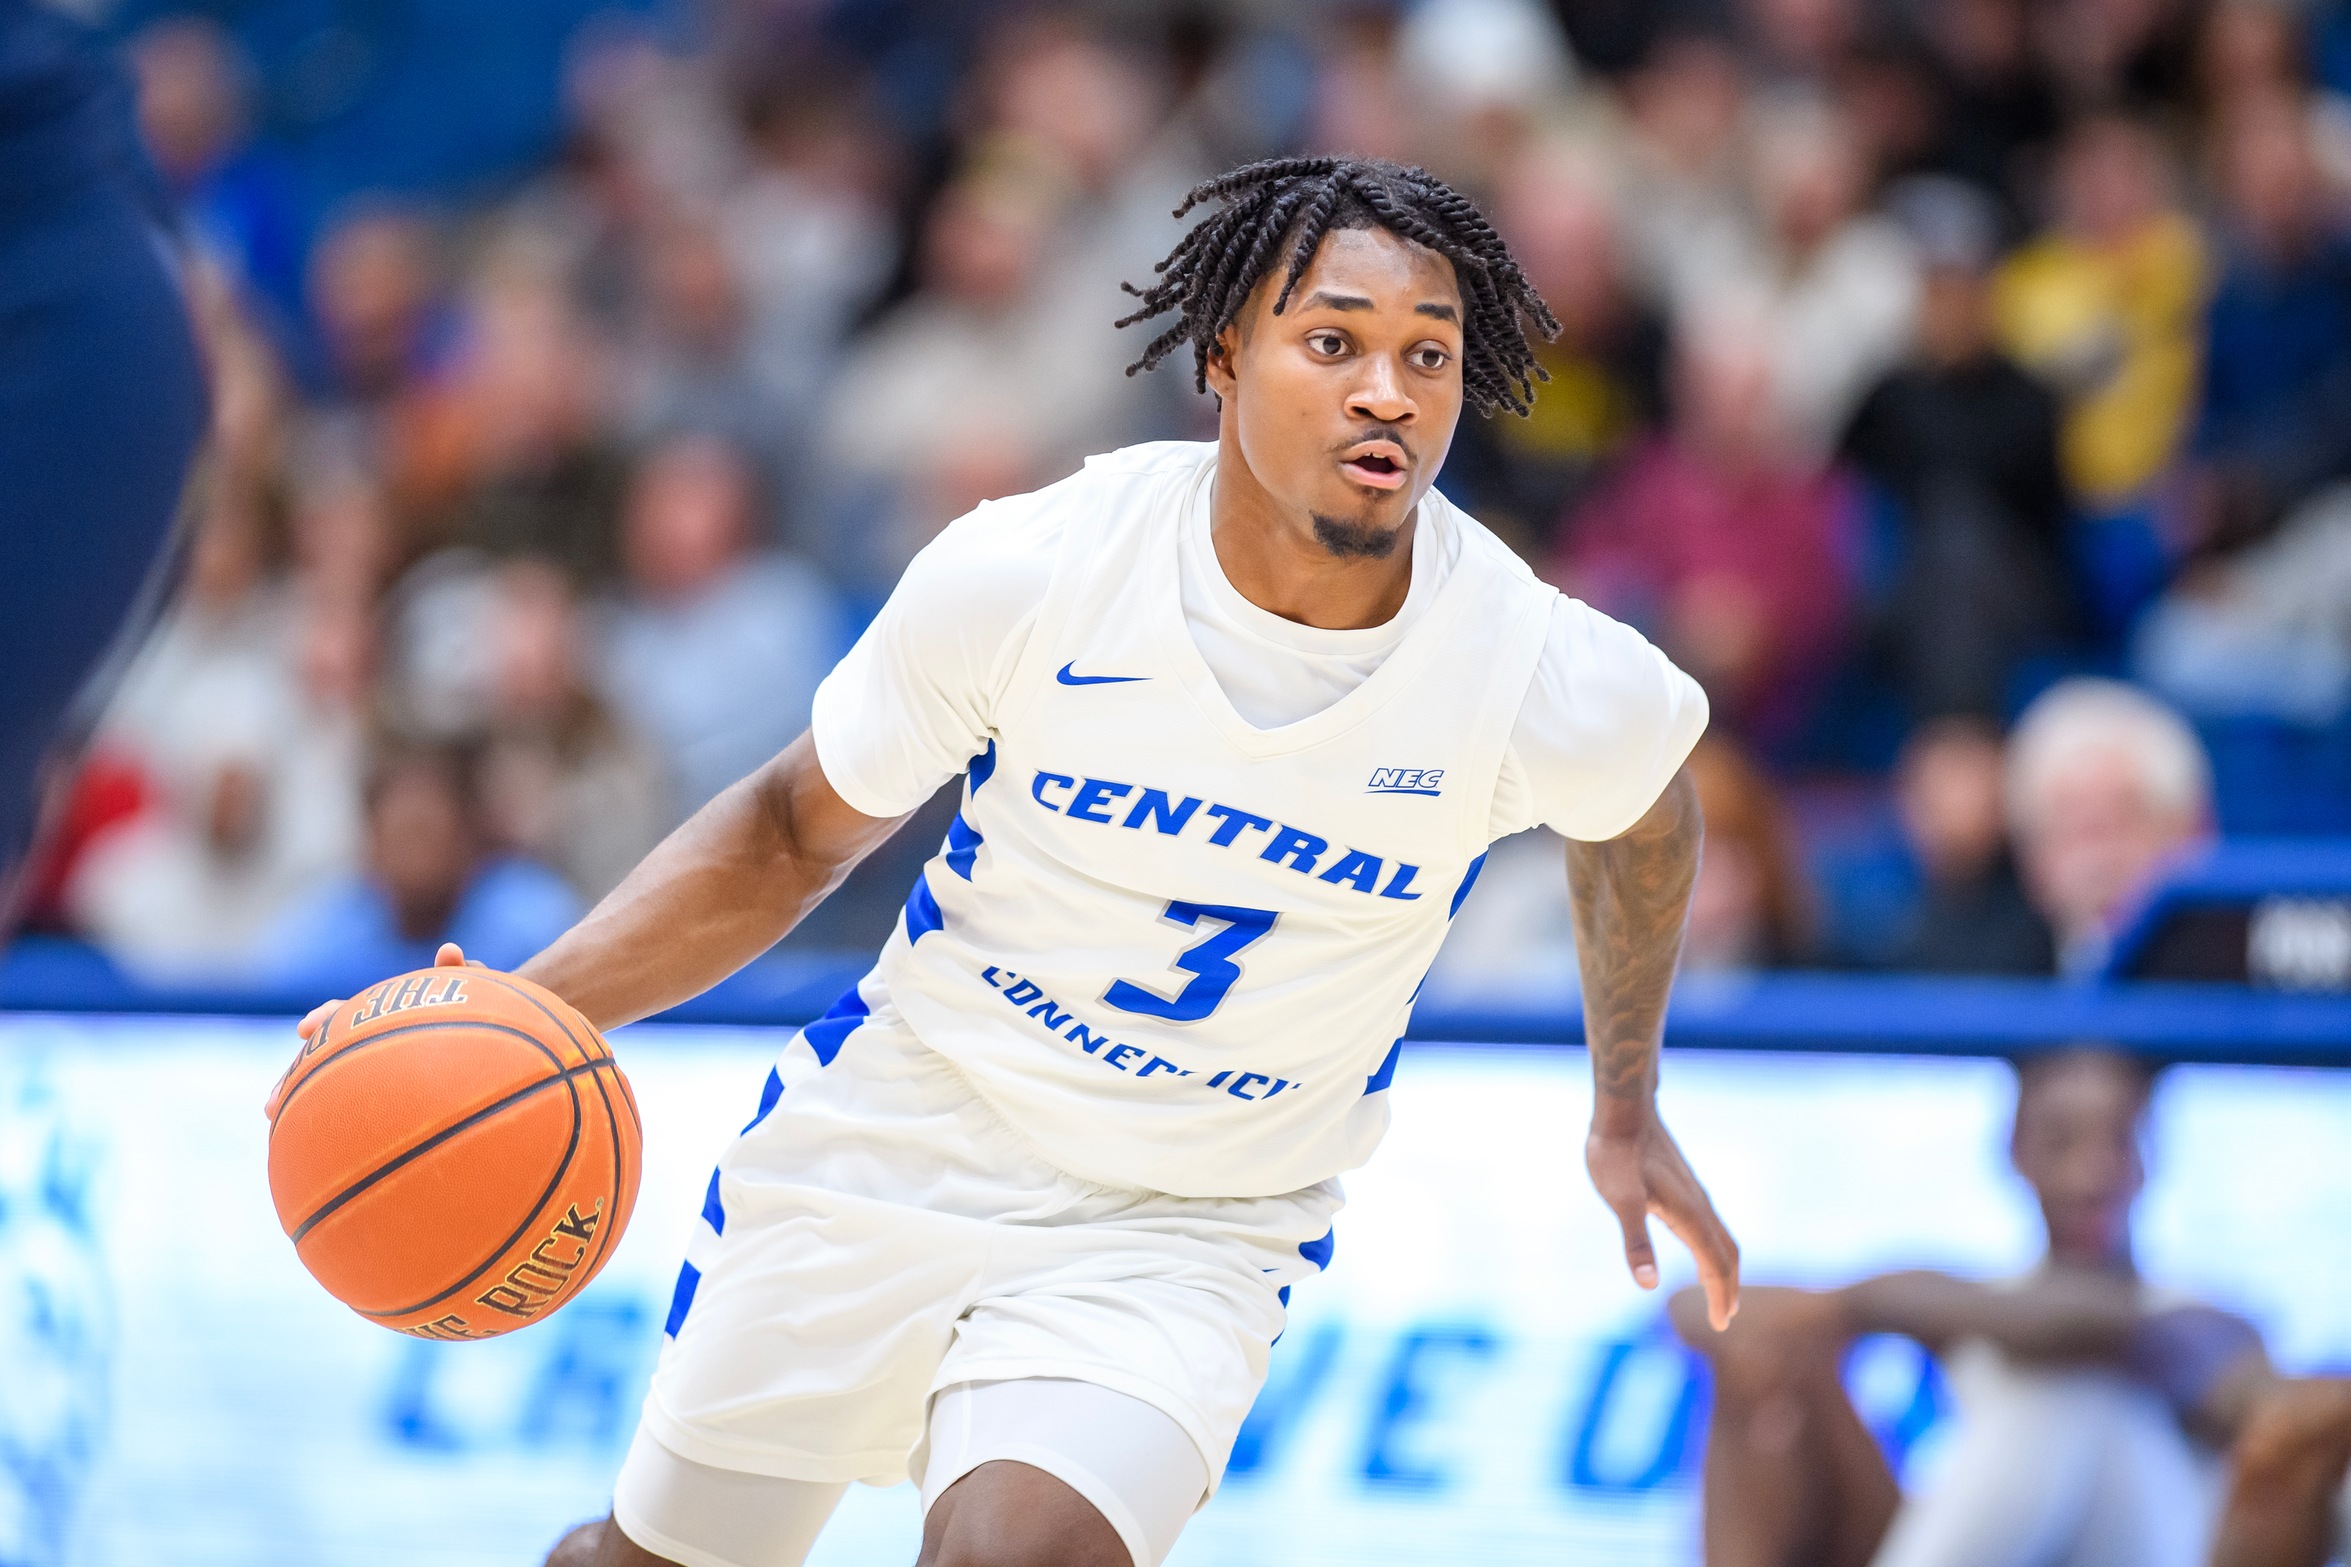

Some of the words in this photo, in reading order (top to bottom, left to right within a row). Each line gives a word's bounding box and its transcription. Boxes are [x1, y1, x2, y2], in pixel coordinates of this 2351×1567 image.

[1030, 769, 1423, 901] CENTRAL
[1368, 768, 1444, 788] NEC
[350, 975, 468, 1030] THE
[1099, 899, 1283, 1024] 3
[981, 965, 1304, 1101] CONNECIC
[474, 1203, 602, 1319] ROCK
